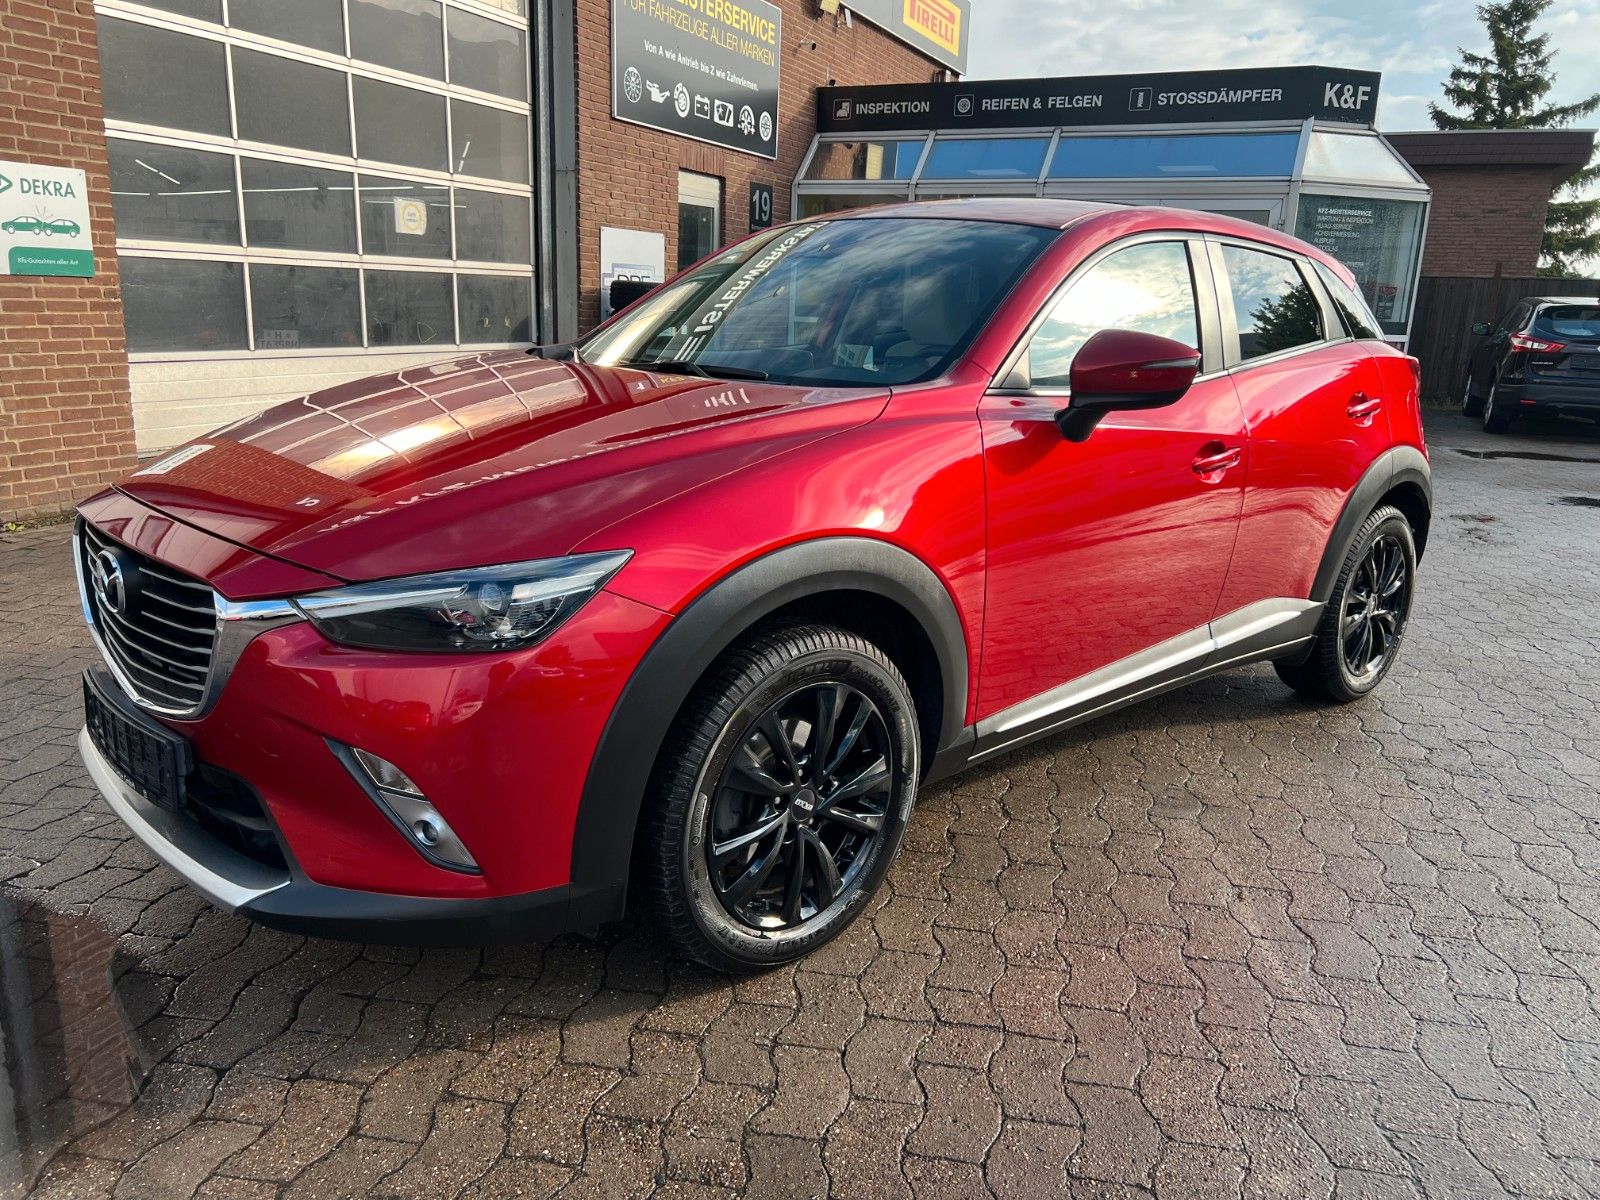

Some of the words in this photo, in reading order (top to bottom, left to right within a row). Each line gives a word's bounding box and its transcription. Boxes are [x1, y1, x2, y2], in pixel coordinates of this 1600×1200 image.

[649, 0, 709, 40] FAHRZEUGE
[710, 26, 738, 52] ALLER
[740, 38, 775, 67] MARKEN
[909, 0, 956, 46] PIRELLI
[644, 40, 657, 54] Von
[658, 45, 664, 57] A
[665, 50, 676, 61] wie
[677, 53, 700, 70] Antrieb
[700, 61, 710, 74] bis
[716, 69, 726, 80] wie
[855, 101, 930, 115] INSPEKTION
[982, 98, 1029, 111] REIFEN
[1032, 97, 1042, 109] &
[1047, 95, 1103, 109] FELGEN
[1157, 88, 1283, 106] STOSSDÄMPFER
[1323, 82, 1371, 109] K&F
[20, 178, 76, 198] DEKRA
[752, 189, 771, 222] 19
